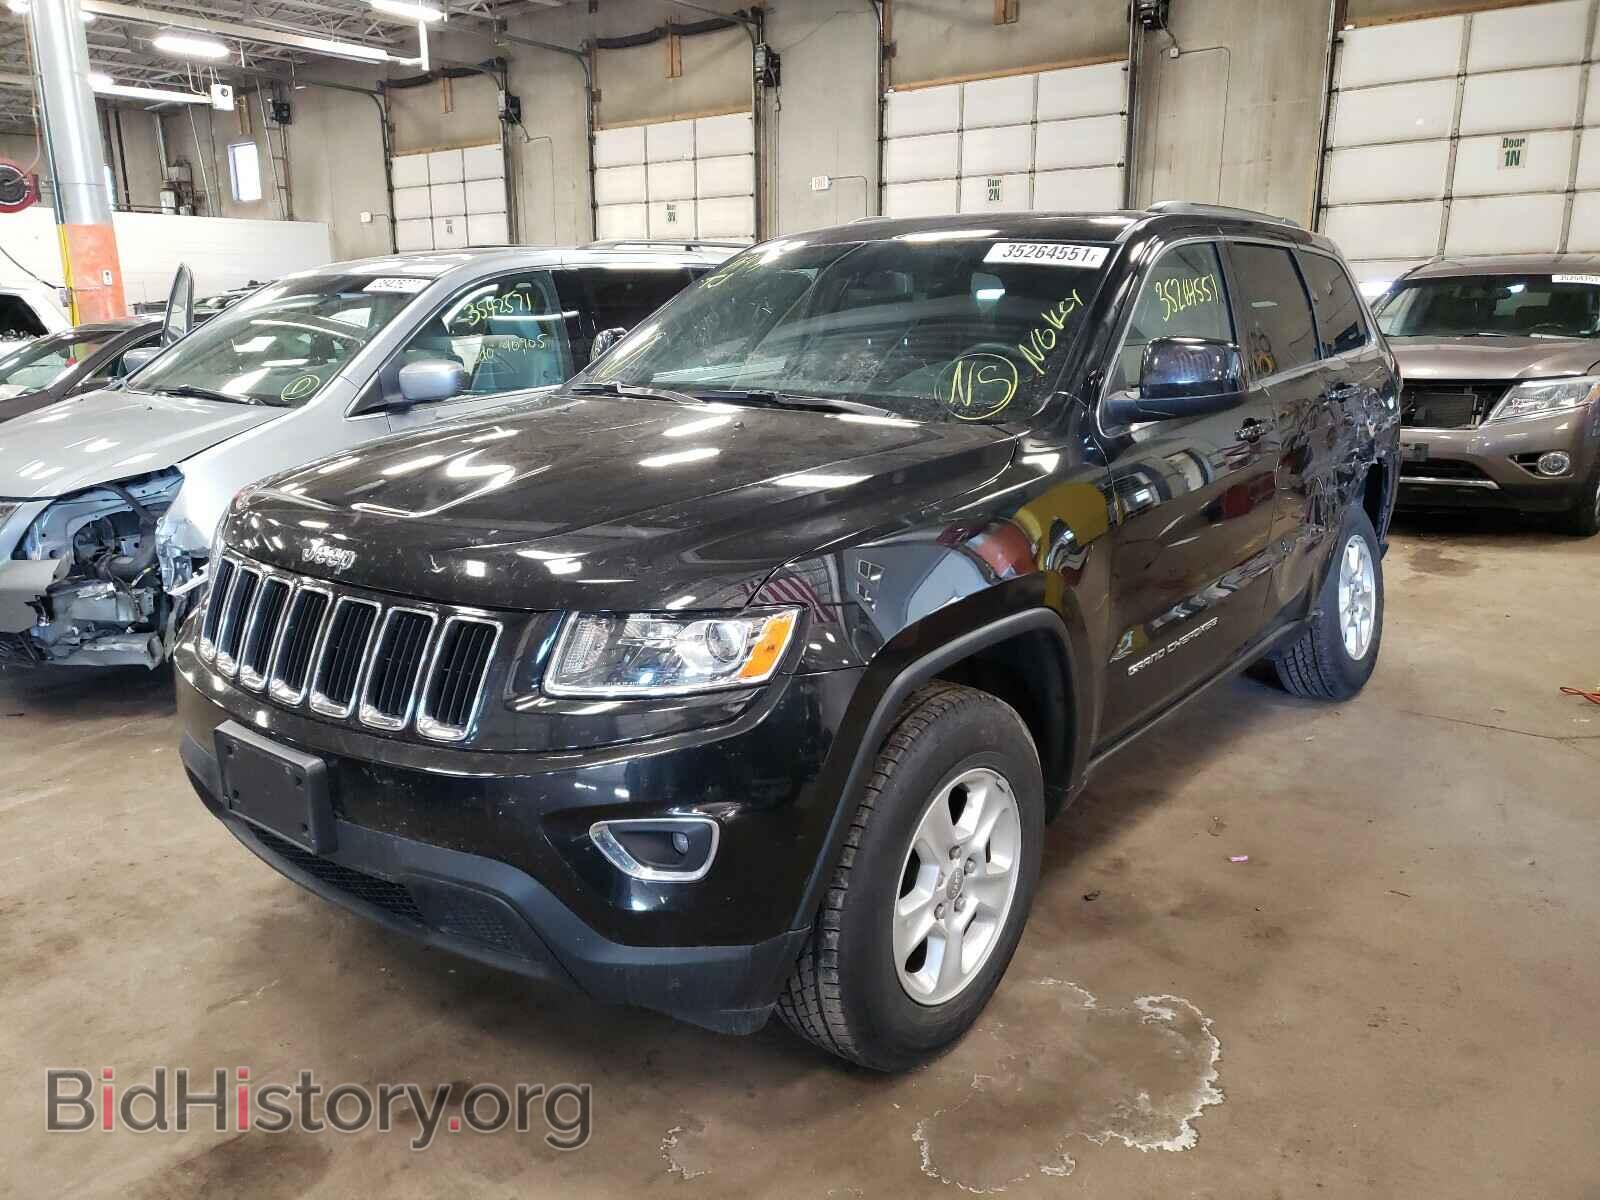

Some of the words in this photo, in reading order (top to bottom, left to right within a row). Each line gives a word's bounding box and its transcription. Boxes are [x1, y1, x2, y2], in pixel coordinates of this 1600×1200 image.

[1502, 137, 1526, 149] Door
[1504, 150, 1521, 167] 1N
[988, 188, 1000, 201] 2N
[1002, 244, 1091, 262] 35264551
[949, 360, 1013, 409] NS
[301, 538, 356, 576] Jeep
[1127, 648, 1166, 677] GRAND
